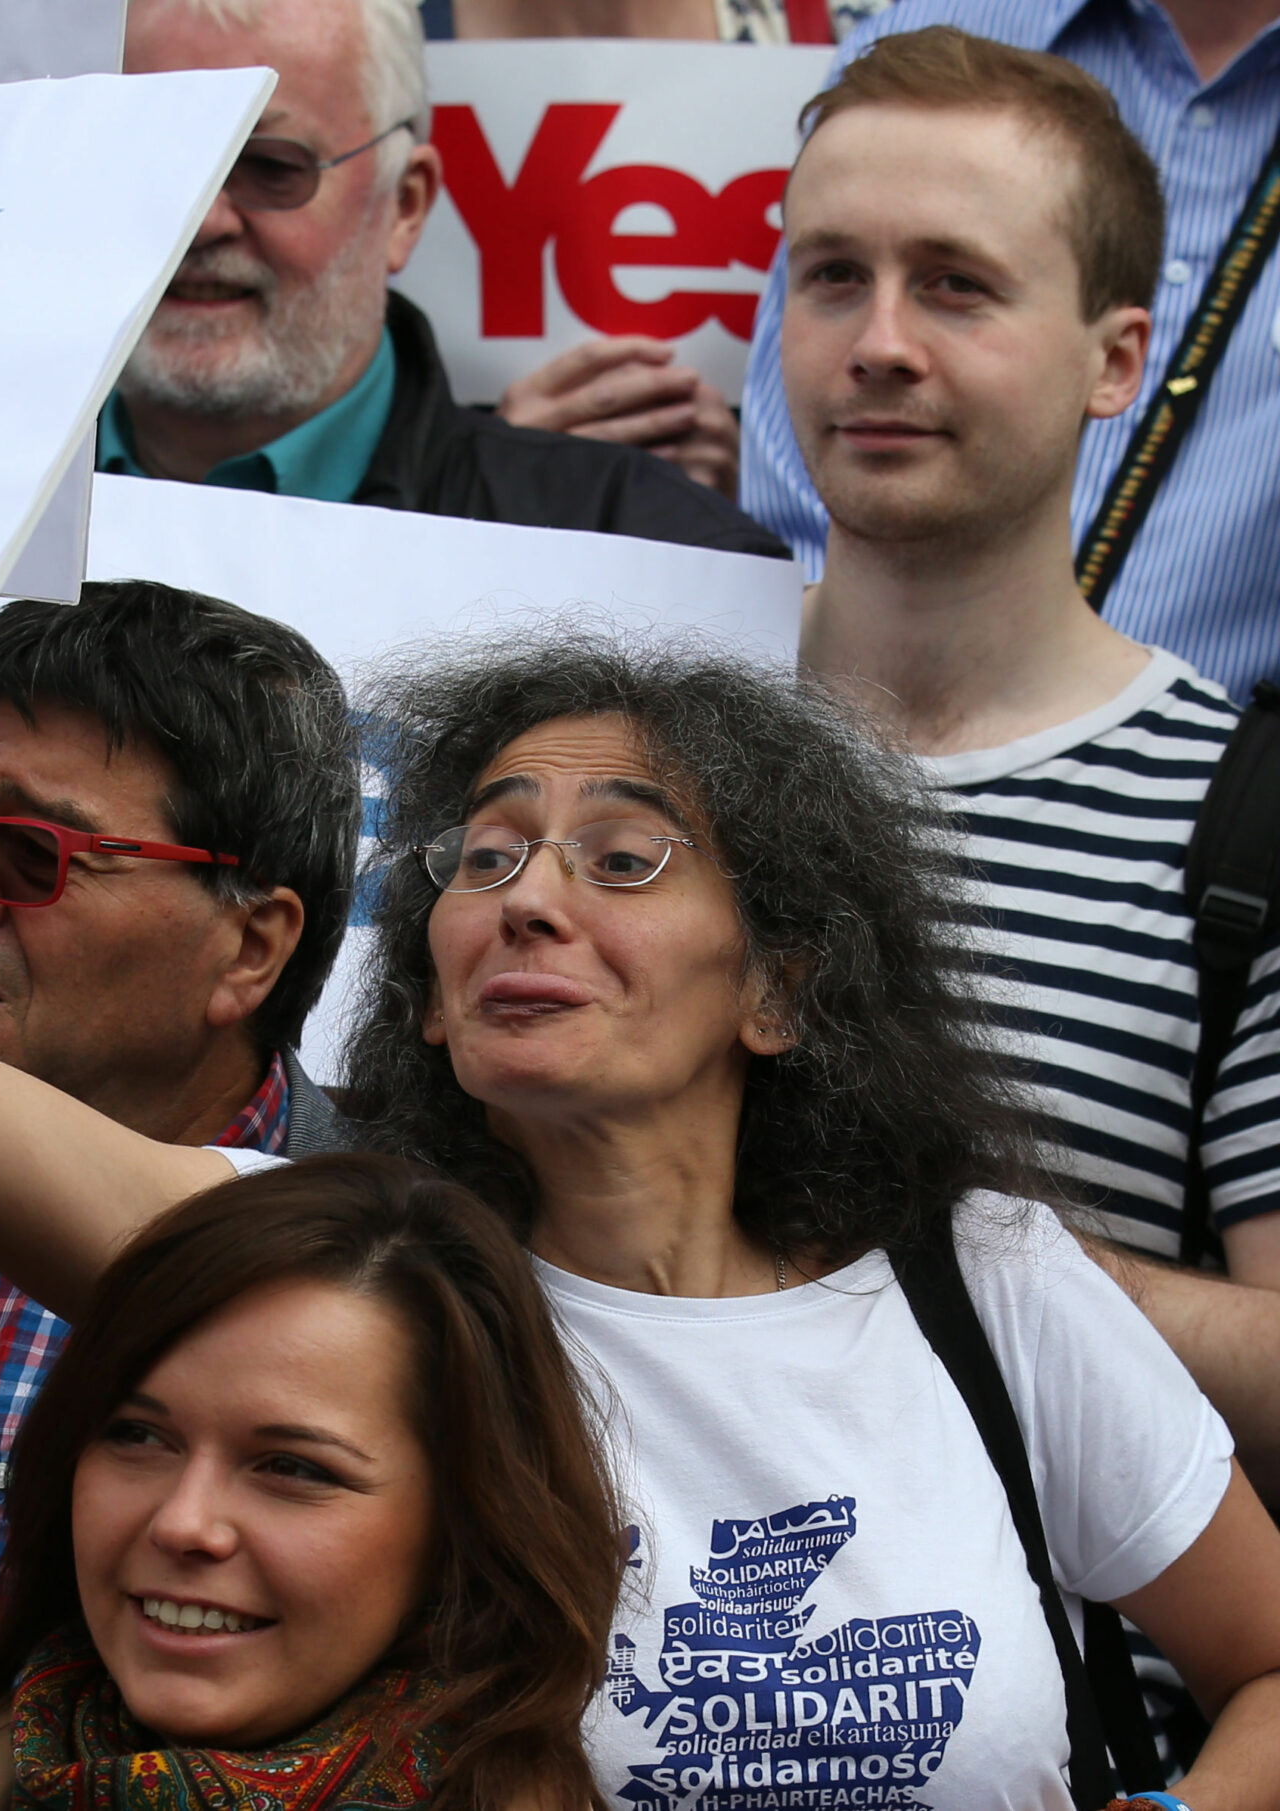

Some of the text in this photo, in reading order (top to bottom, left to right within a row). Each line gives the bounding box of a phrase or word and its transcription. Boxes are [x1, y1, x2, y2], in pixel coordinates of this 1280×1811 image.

[742, 1531, 852, 1559] solidarumas
[692, 1551, 829, 1585] SZOLIDARITÁS
[699, 1594, 802, 1616] solidaarisuus
[781, 1644, 976, 1686] solidarité
[665, 1720, 956, 1756] solidaridad elkartasuna
[652, 1738, 942, 1793] solidarność
